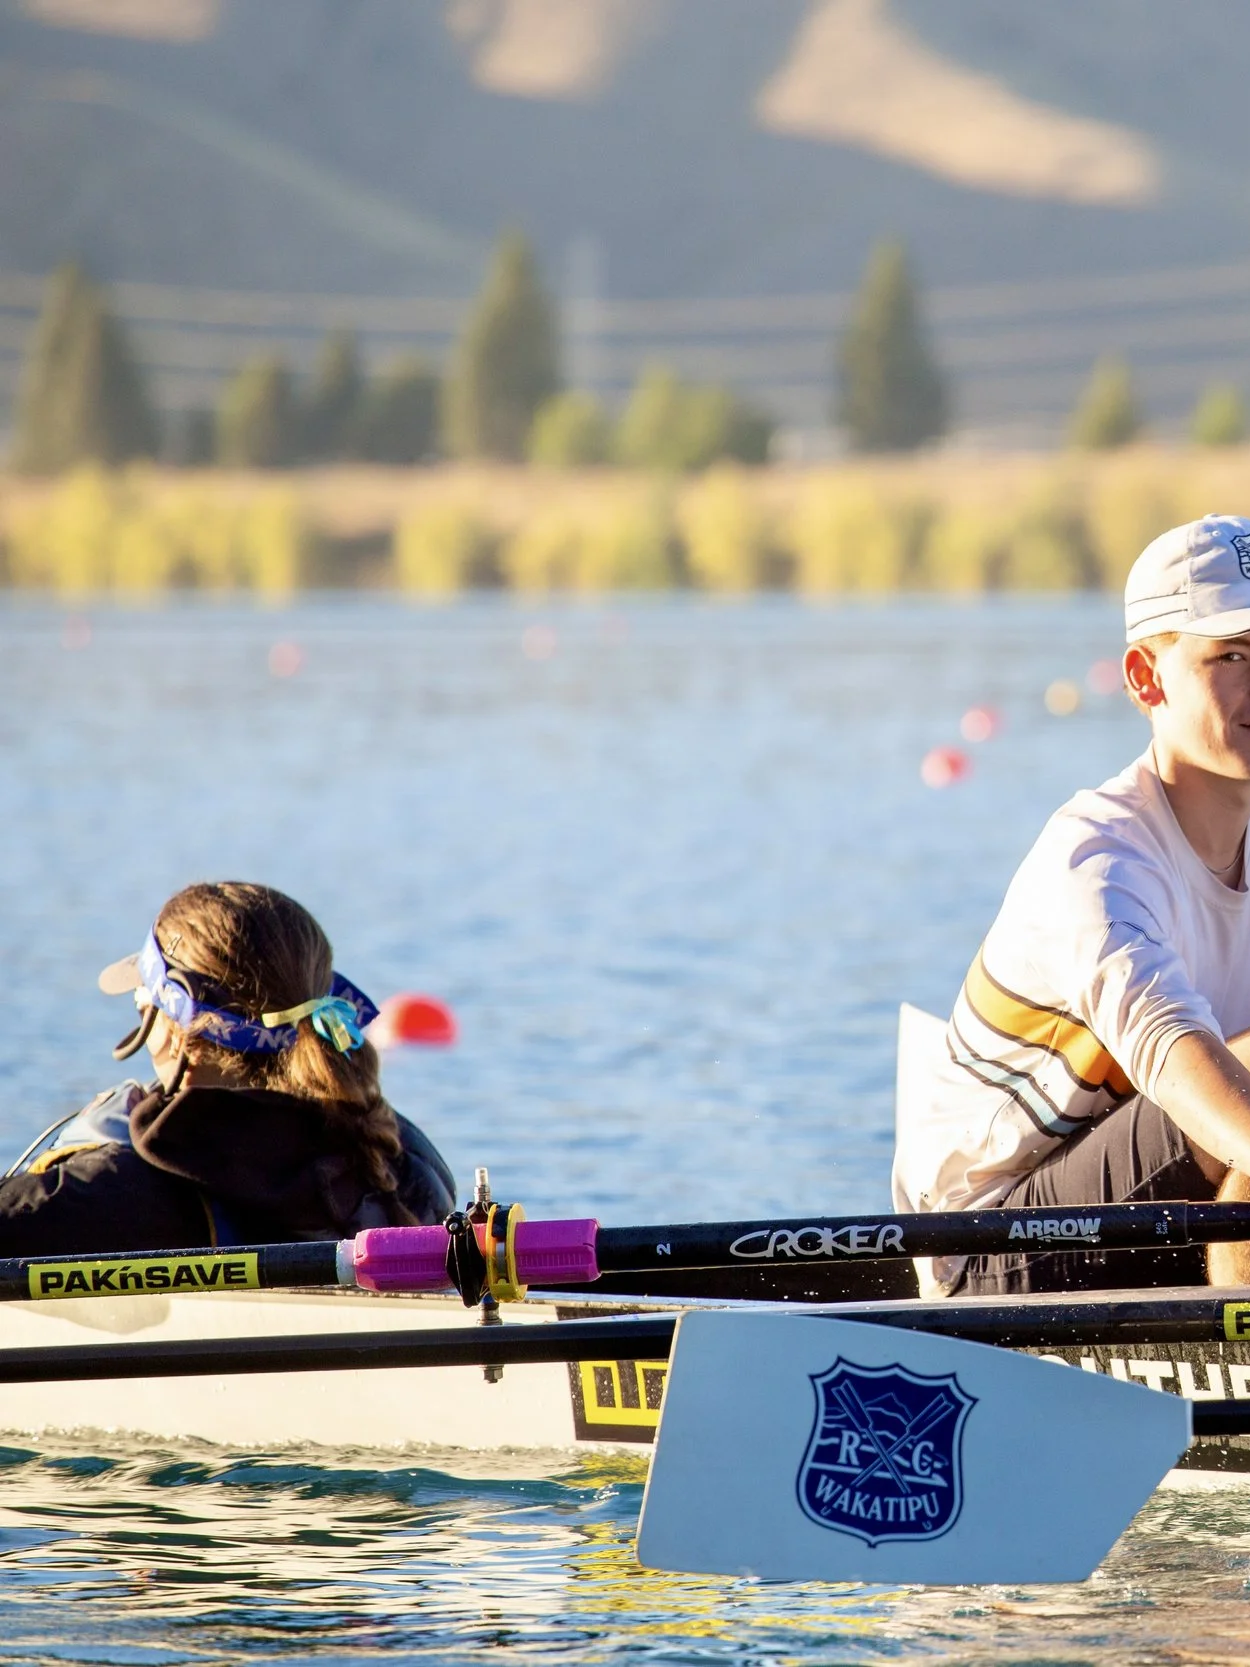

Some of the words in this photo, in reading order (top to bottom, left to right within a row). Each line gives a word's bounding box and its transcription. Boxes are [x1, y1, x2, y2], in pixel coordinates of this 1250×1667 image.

[729, 1224, 906, 1259] CROKER
[1007, 1217, 1102, 1240] ARROW
[836, 1429, 862, 1466] R
[911, 1440, 935, 1476] C
[814, 1473, 940, 1522] WAKATIPU
